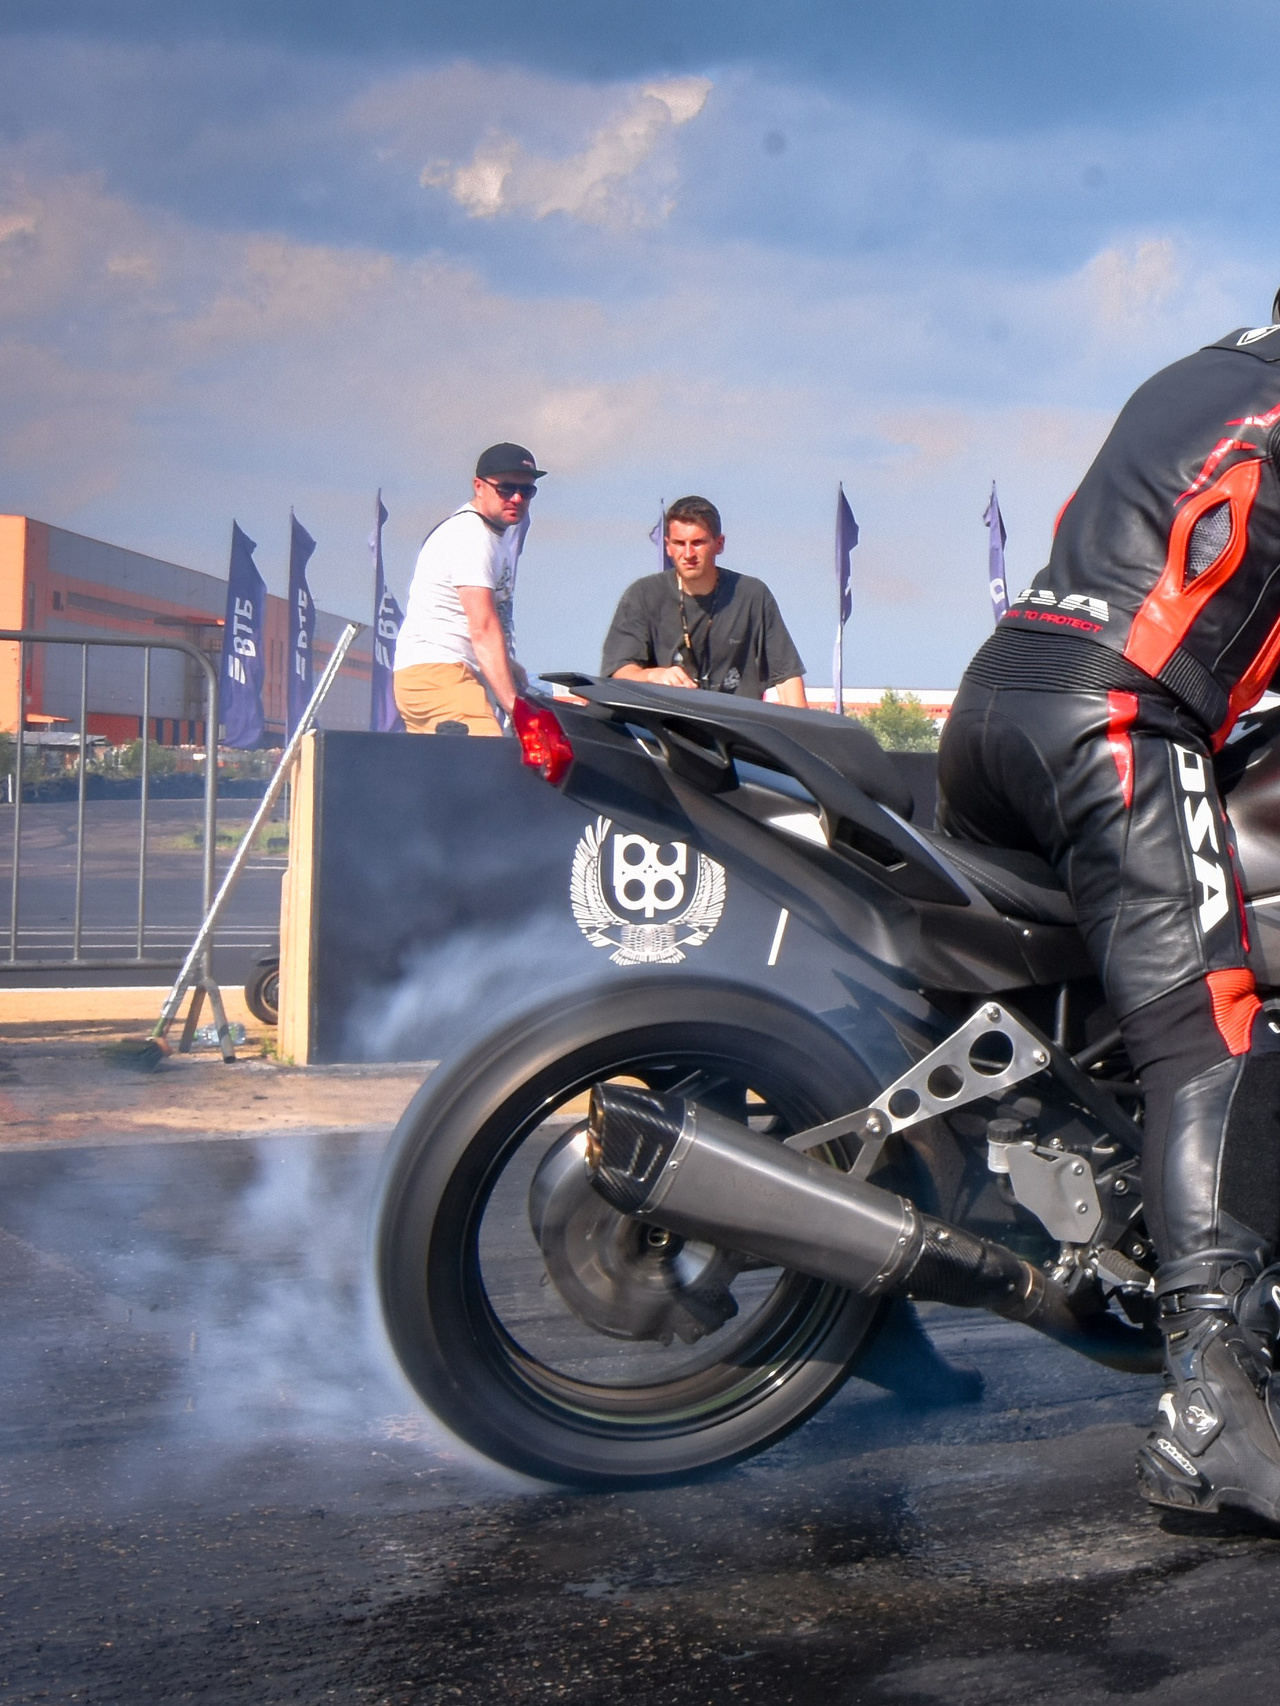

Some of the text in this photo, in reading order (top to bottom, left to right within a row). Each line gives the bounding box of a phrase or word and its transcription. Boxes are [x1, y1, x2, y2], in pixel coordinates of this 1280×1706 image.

[233, 596, 257, 658] ВТБ
[1024, 610, 1039, 621] TO
[1039, 612, 1104, 633] PROTECT
